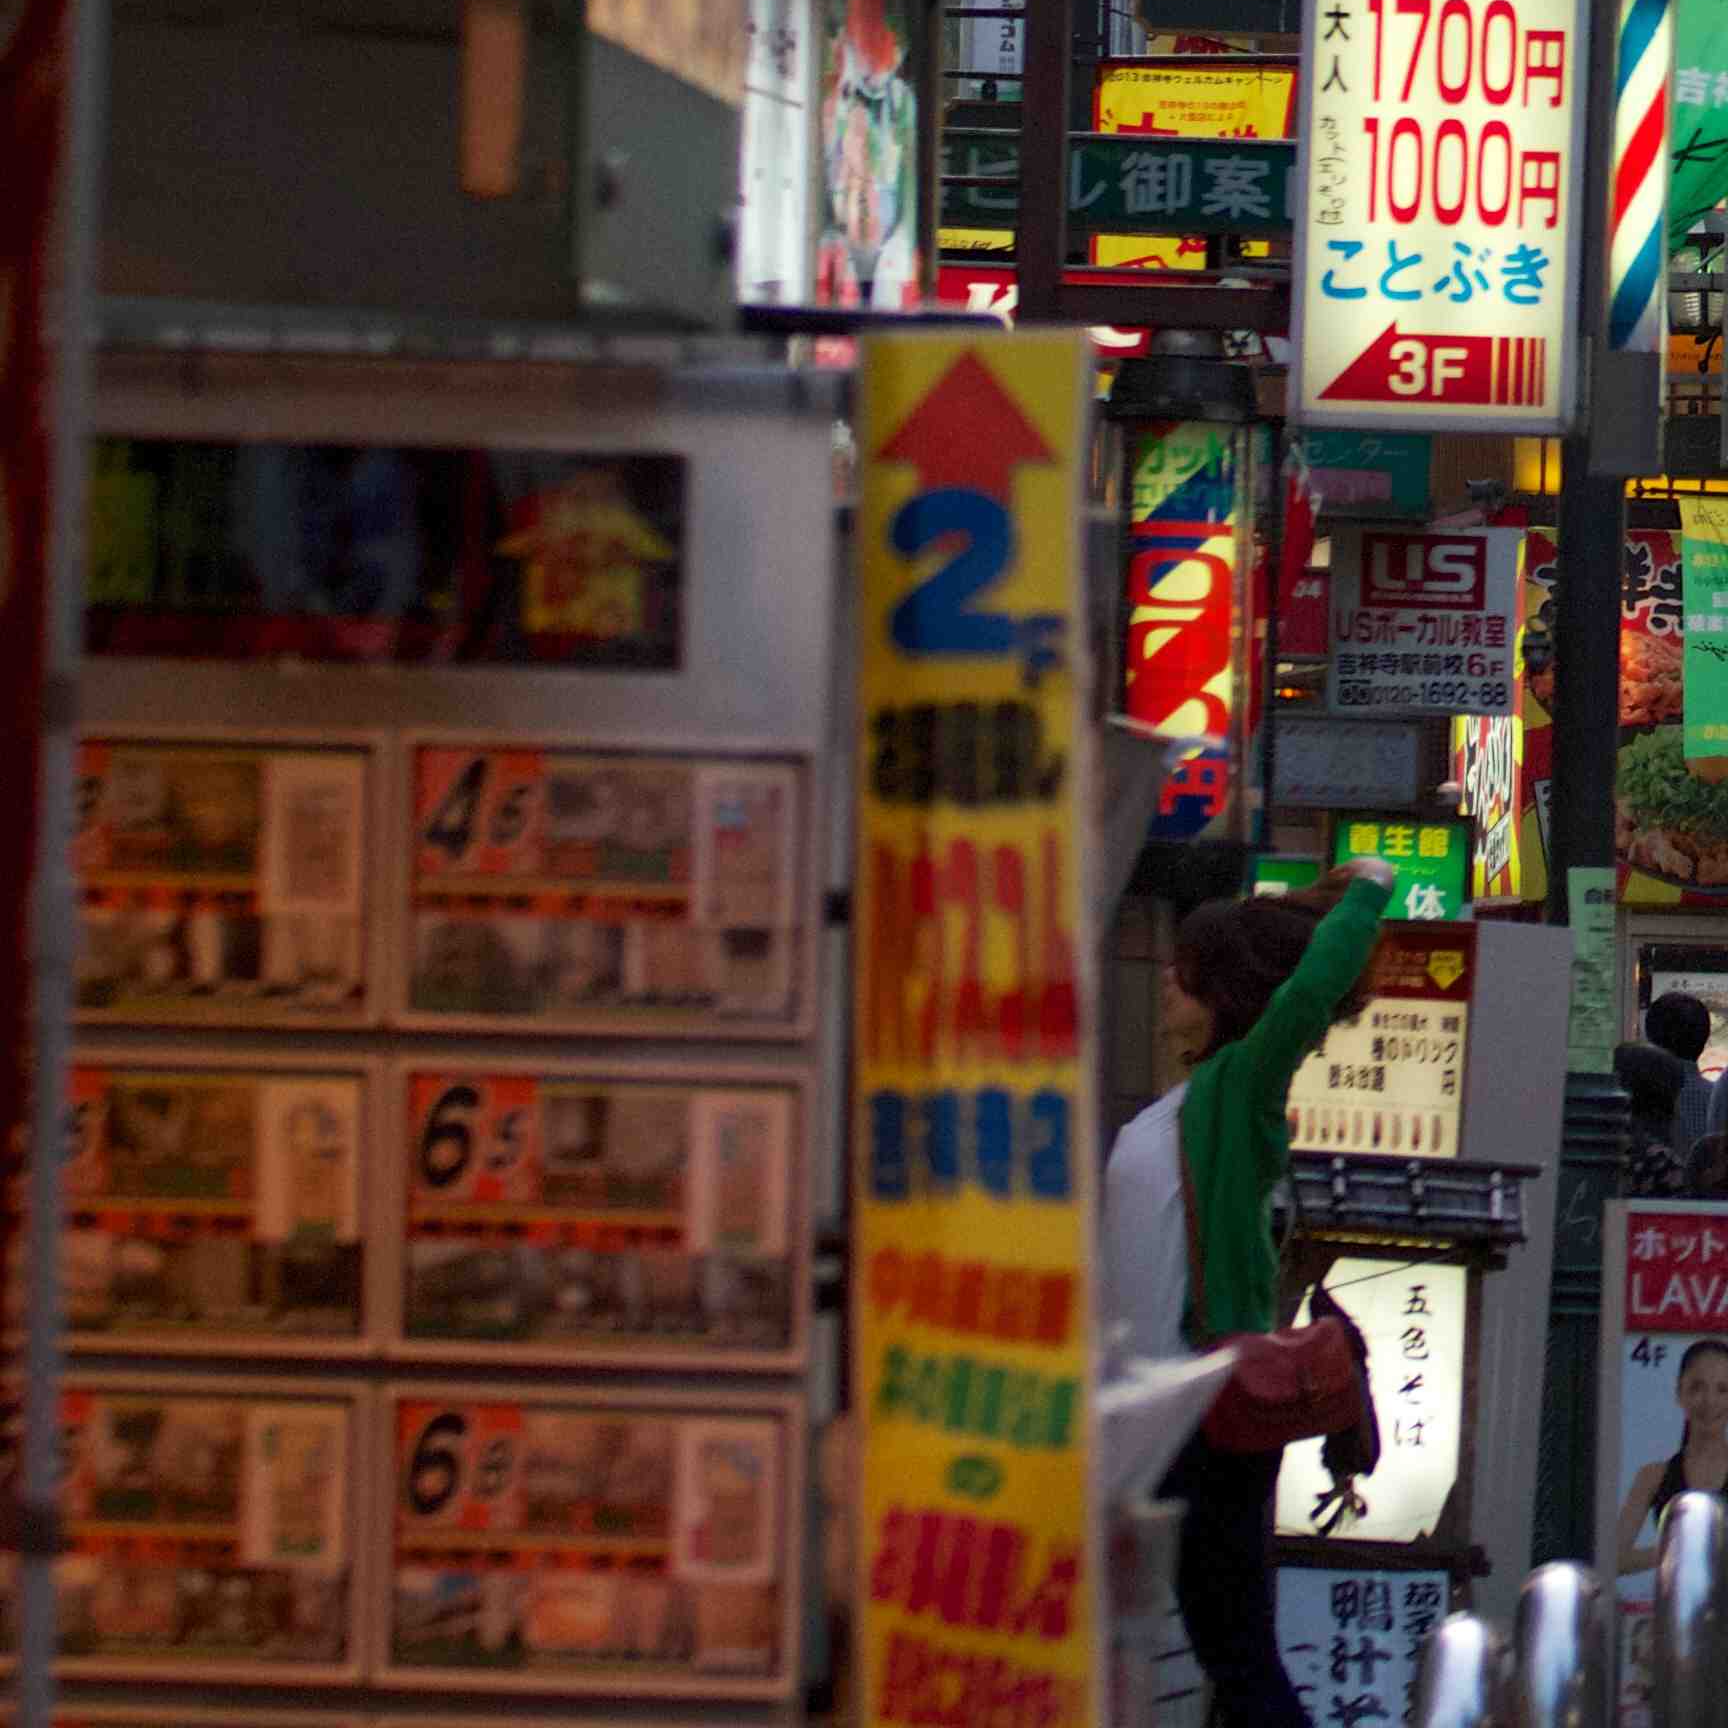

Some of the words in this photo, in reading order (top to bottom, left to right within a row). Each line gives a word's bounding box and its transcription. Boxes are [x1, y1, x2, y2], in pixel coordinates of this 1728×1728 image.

[1322, 4, 1352, 94] 大人
[1363, 116, 1562, 230] 1000円
[1321, 239, 1550, 305] ことぶき
[1387, 339, 1469, 397] 3F
[1349, 827, 1450, 857] 養生館
[1392, 1282, 1434, 1450] 五色そば
[1629, 1334, 1666, 1370] 4F
